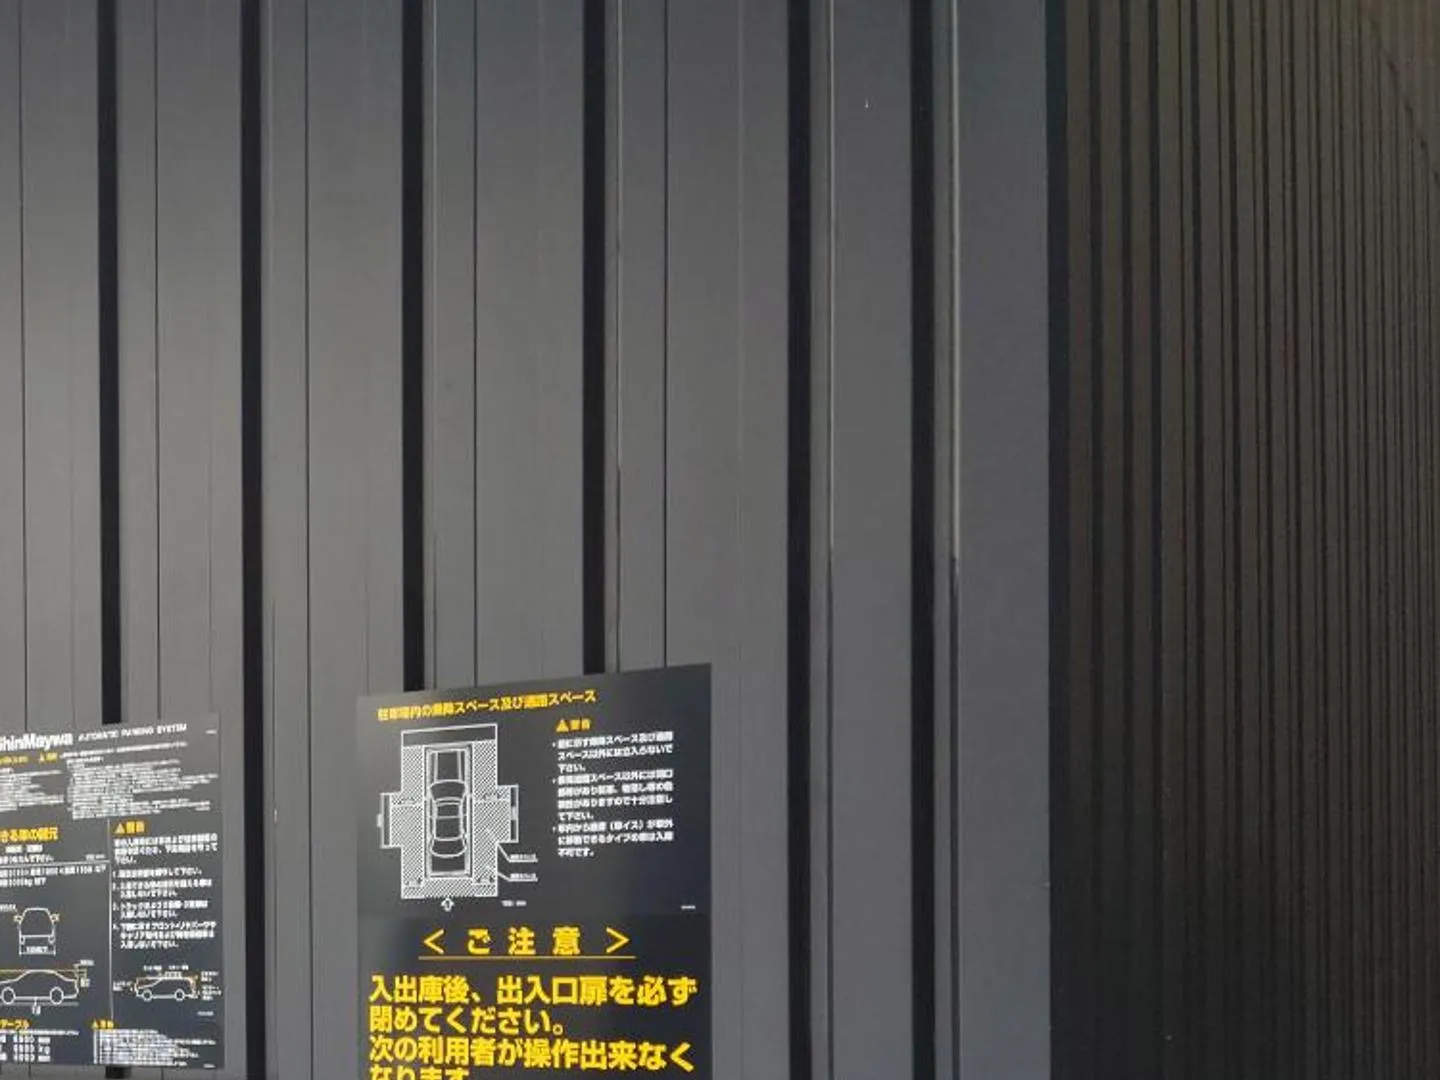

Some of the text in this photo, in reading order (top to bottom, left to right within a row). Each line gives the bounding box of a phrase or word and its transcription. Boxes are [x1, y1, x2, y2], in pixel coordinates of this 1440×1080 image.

[369, 974, 698, 1006] 入出庫後、出入口扉を必ず
[369, 1005, 564, 1035] 閉めてください。
[369, 1035, 695, 1073] 次の利用者が操作出来なく
